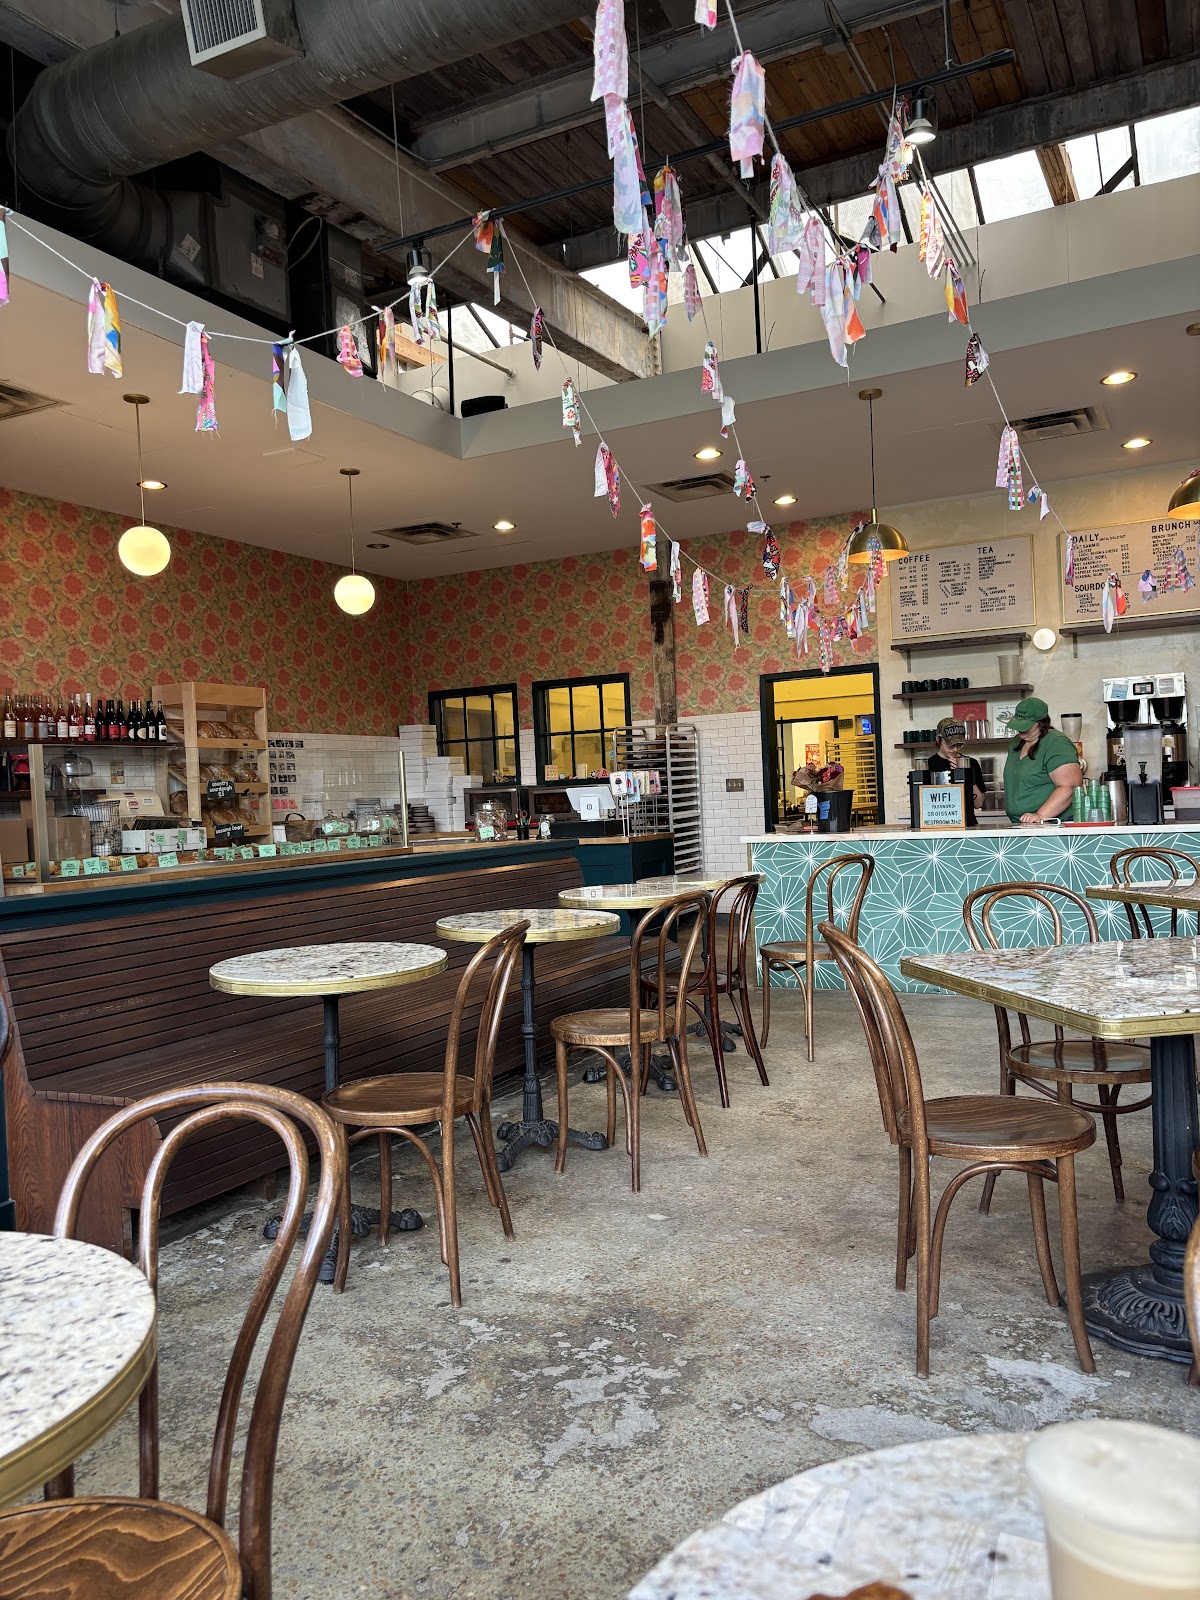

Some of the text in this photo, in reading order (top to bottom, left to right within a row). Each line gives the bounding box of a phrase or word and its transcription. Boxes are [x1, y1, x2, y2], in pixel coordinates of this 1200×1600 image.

[1151, 520, 1190, 533] BRUNCH
[1072, 533, 1099, 543] DAILY
[977, 546, 993, 554] TEA
[898, 554, 930, 564] COFFEE
[930, 792, 951, 802] WIFI
